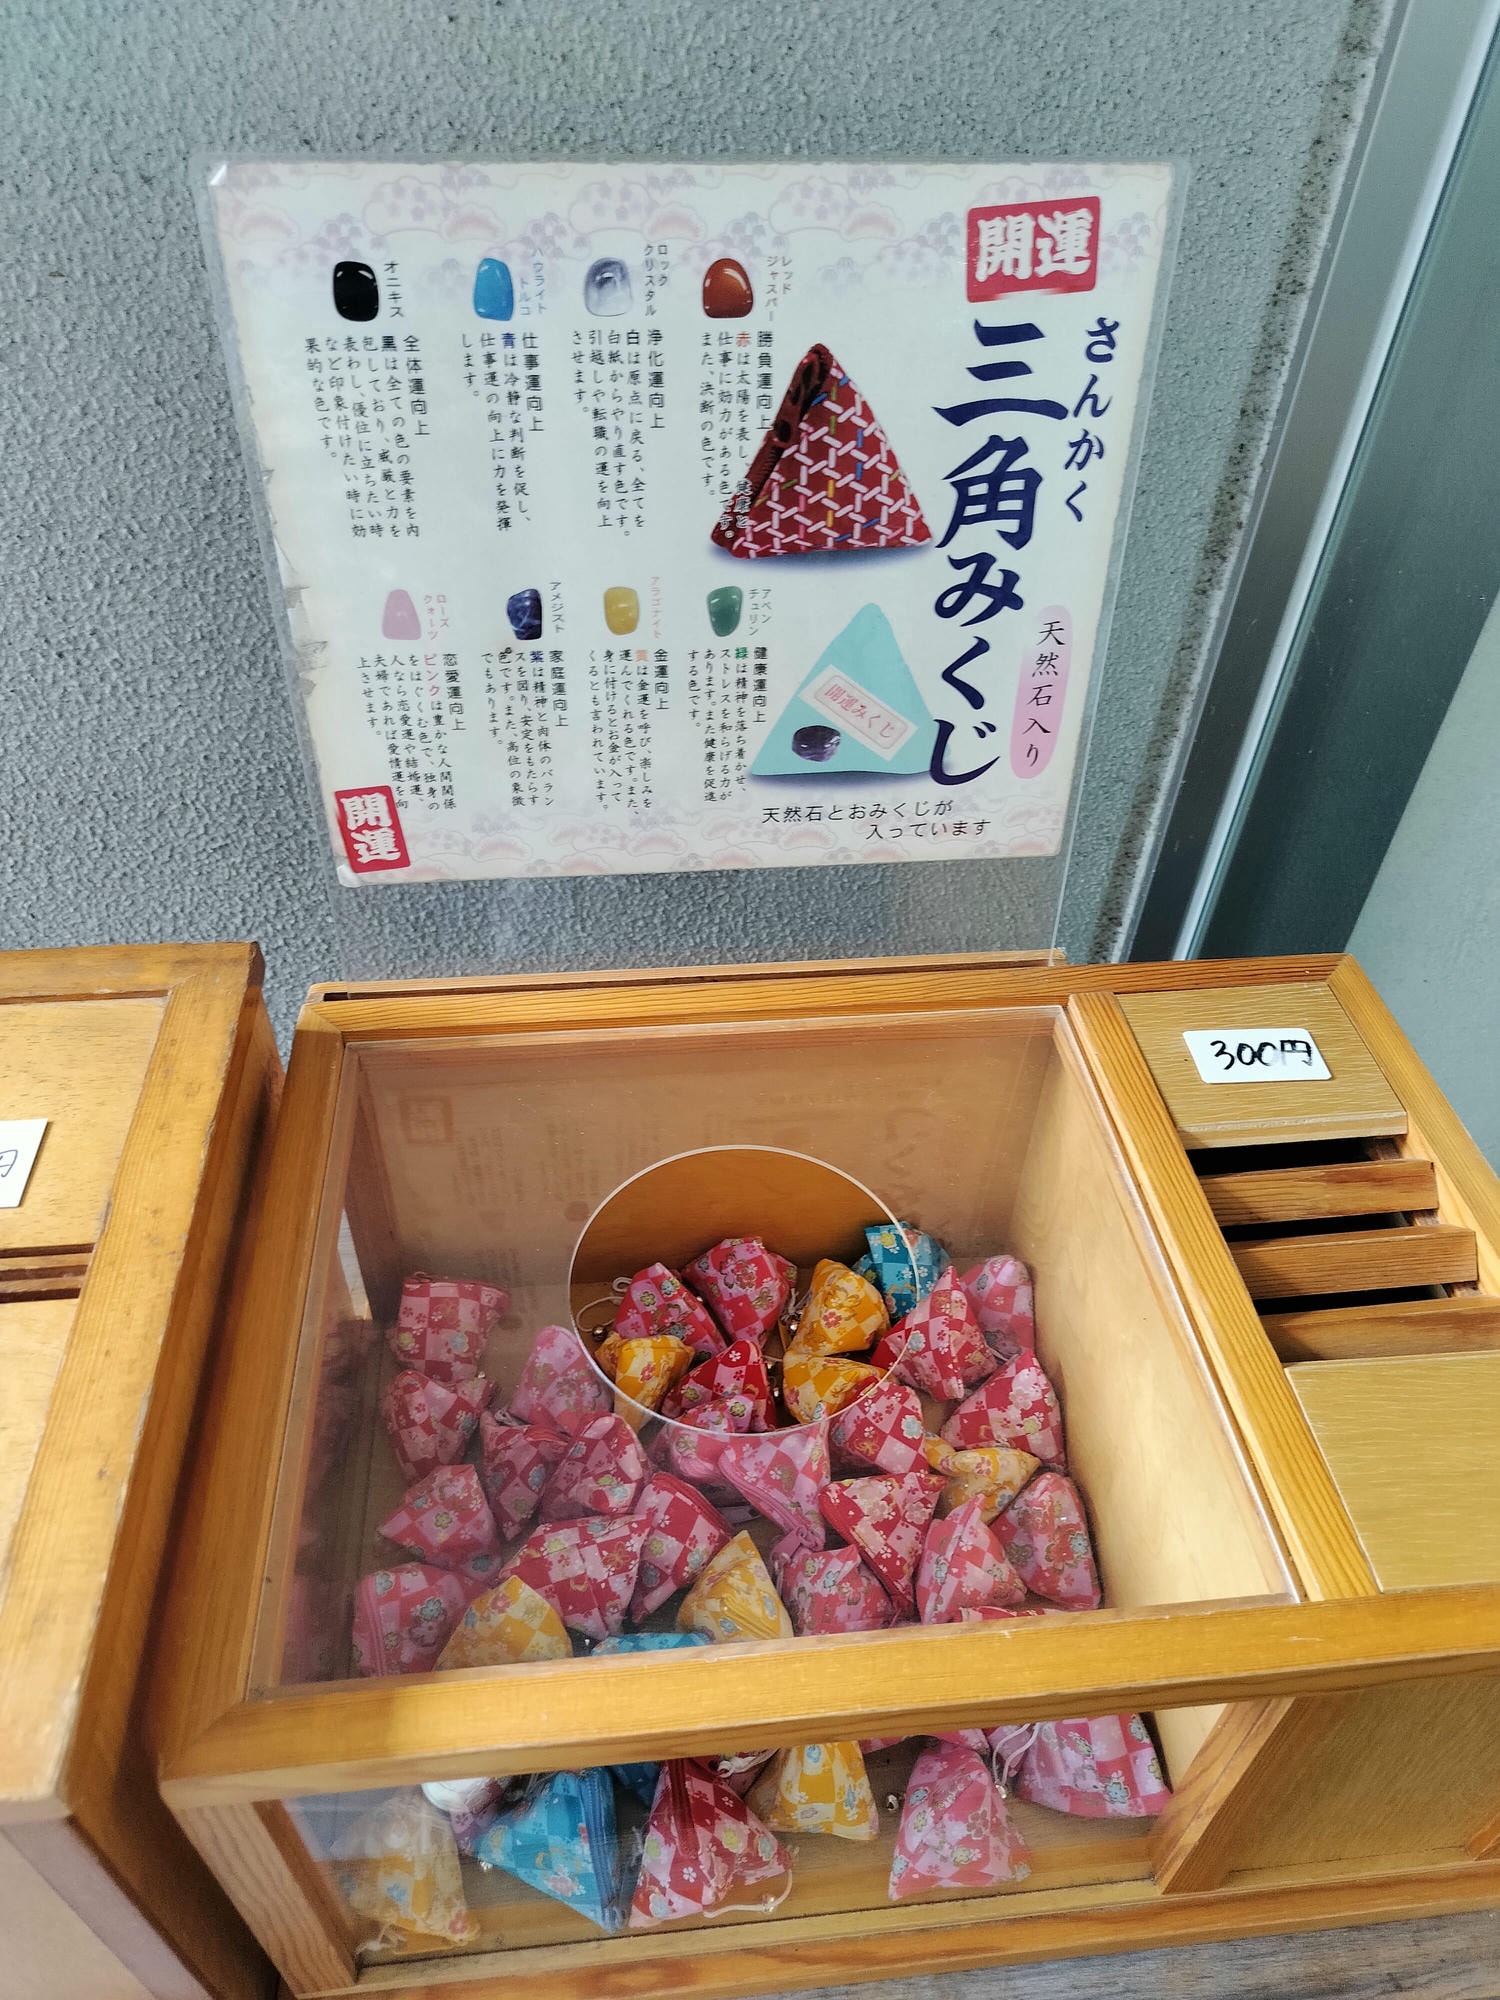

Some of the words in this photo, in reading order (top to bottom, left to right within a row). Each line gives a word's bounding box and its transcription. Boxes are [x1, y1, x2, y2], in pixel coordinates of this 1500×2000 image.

[643, 244, 657, 316] クリスタル
[657, 244, 669, 287] ロック
[781, 255, 794, 295] レッド
[973, 207, 1095, 284] 開運
[384, 261, 404, 318] オニキス
[402, 335, 430, 435] 全体運向上
[462, 333, 480, 397] します。
[522, 332, 544, 431] 仕事運向上
[571, 330, 589, 412] させます。
[647, 329, 665, 428] 浄化運向上
[756, 331, 774, 430] 勝負運向上
[1063, 317, 1120, 523] さんかく
[930, 319, 1069, 785] 三角みくじ
[550, 581, 565, 633] アメジスト
[443, 653, 466, 731] 恋愛運向上
[549, 650, 569, 727] 家庭運向上
[654, 648, 671, 710] 金運向上
[687, 648, 701, 727] する色です。
[752, 646, 768, 723] 健康運向上
[1022, 621, 1065, 768] 天然石入り
[339, 792, 401, 864] 開運
[762, 799, 953, 824] 天然石とおみくじが
[866, 819, 991, 840] 入っています
